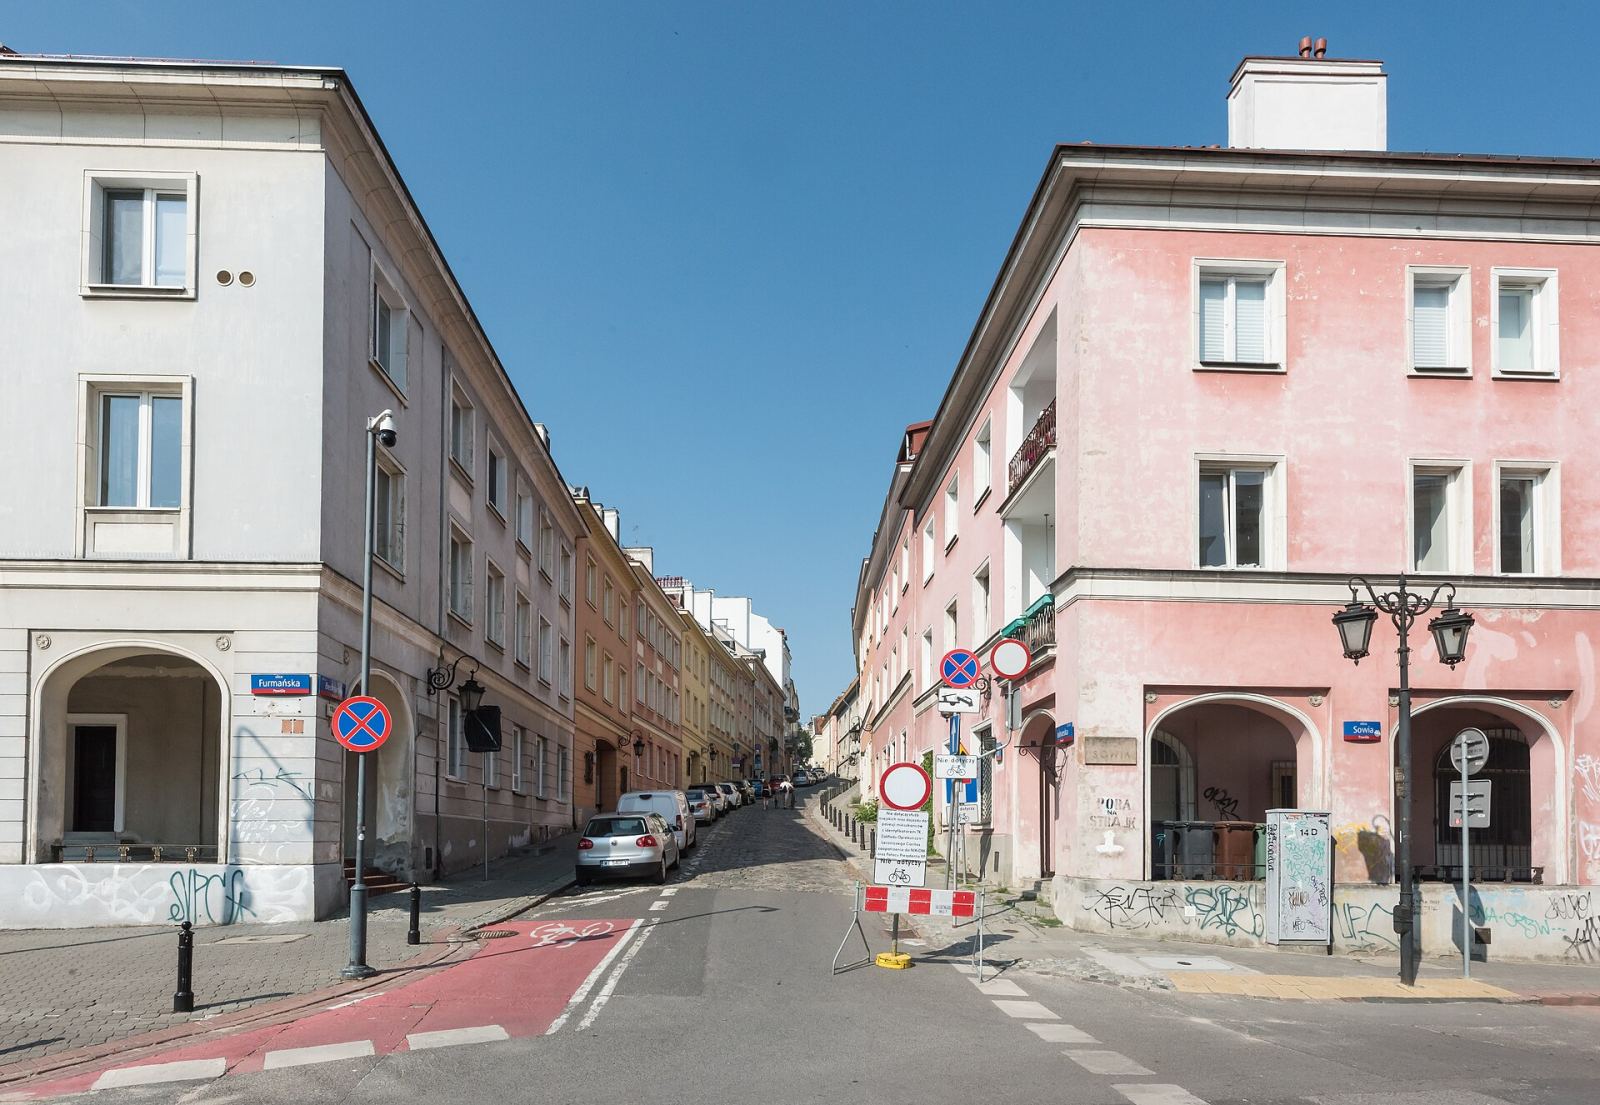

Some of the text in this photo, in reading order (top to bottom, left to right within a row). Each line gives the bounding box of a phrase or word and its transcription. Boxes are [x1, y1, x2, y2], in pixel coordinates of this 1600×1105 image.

[258, 678, 300, 687] Furmańska
[1352, 725, 1374, 734] Sowia
[1311, 828, 1318, 836] D
